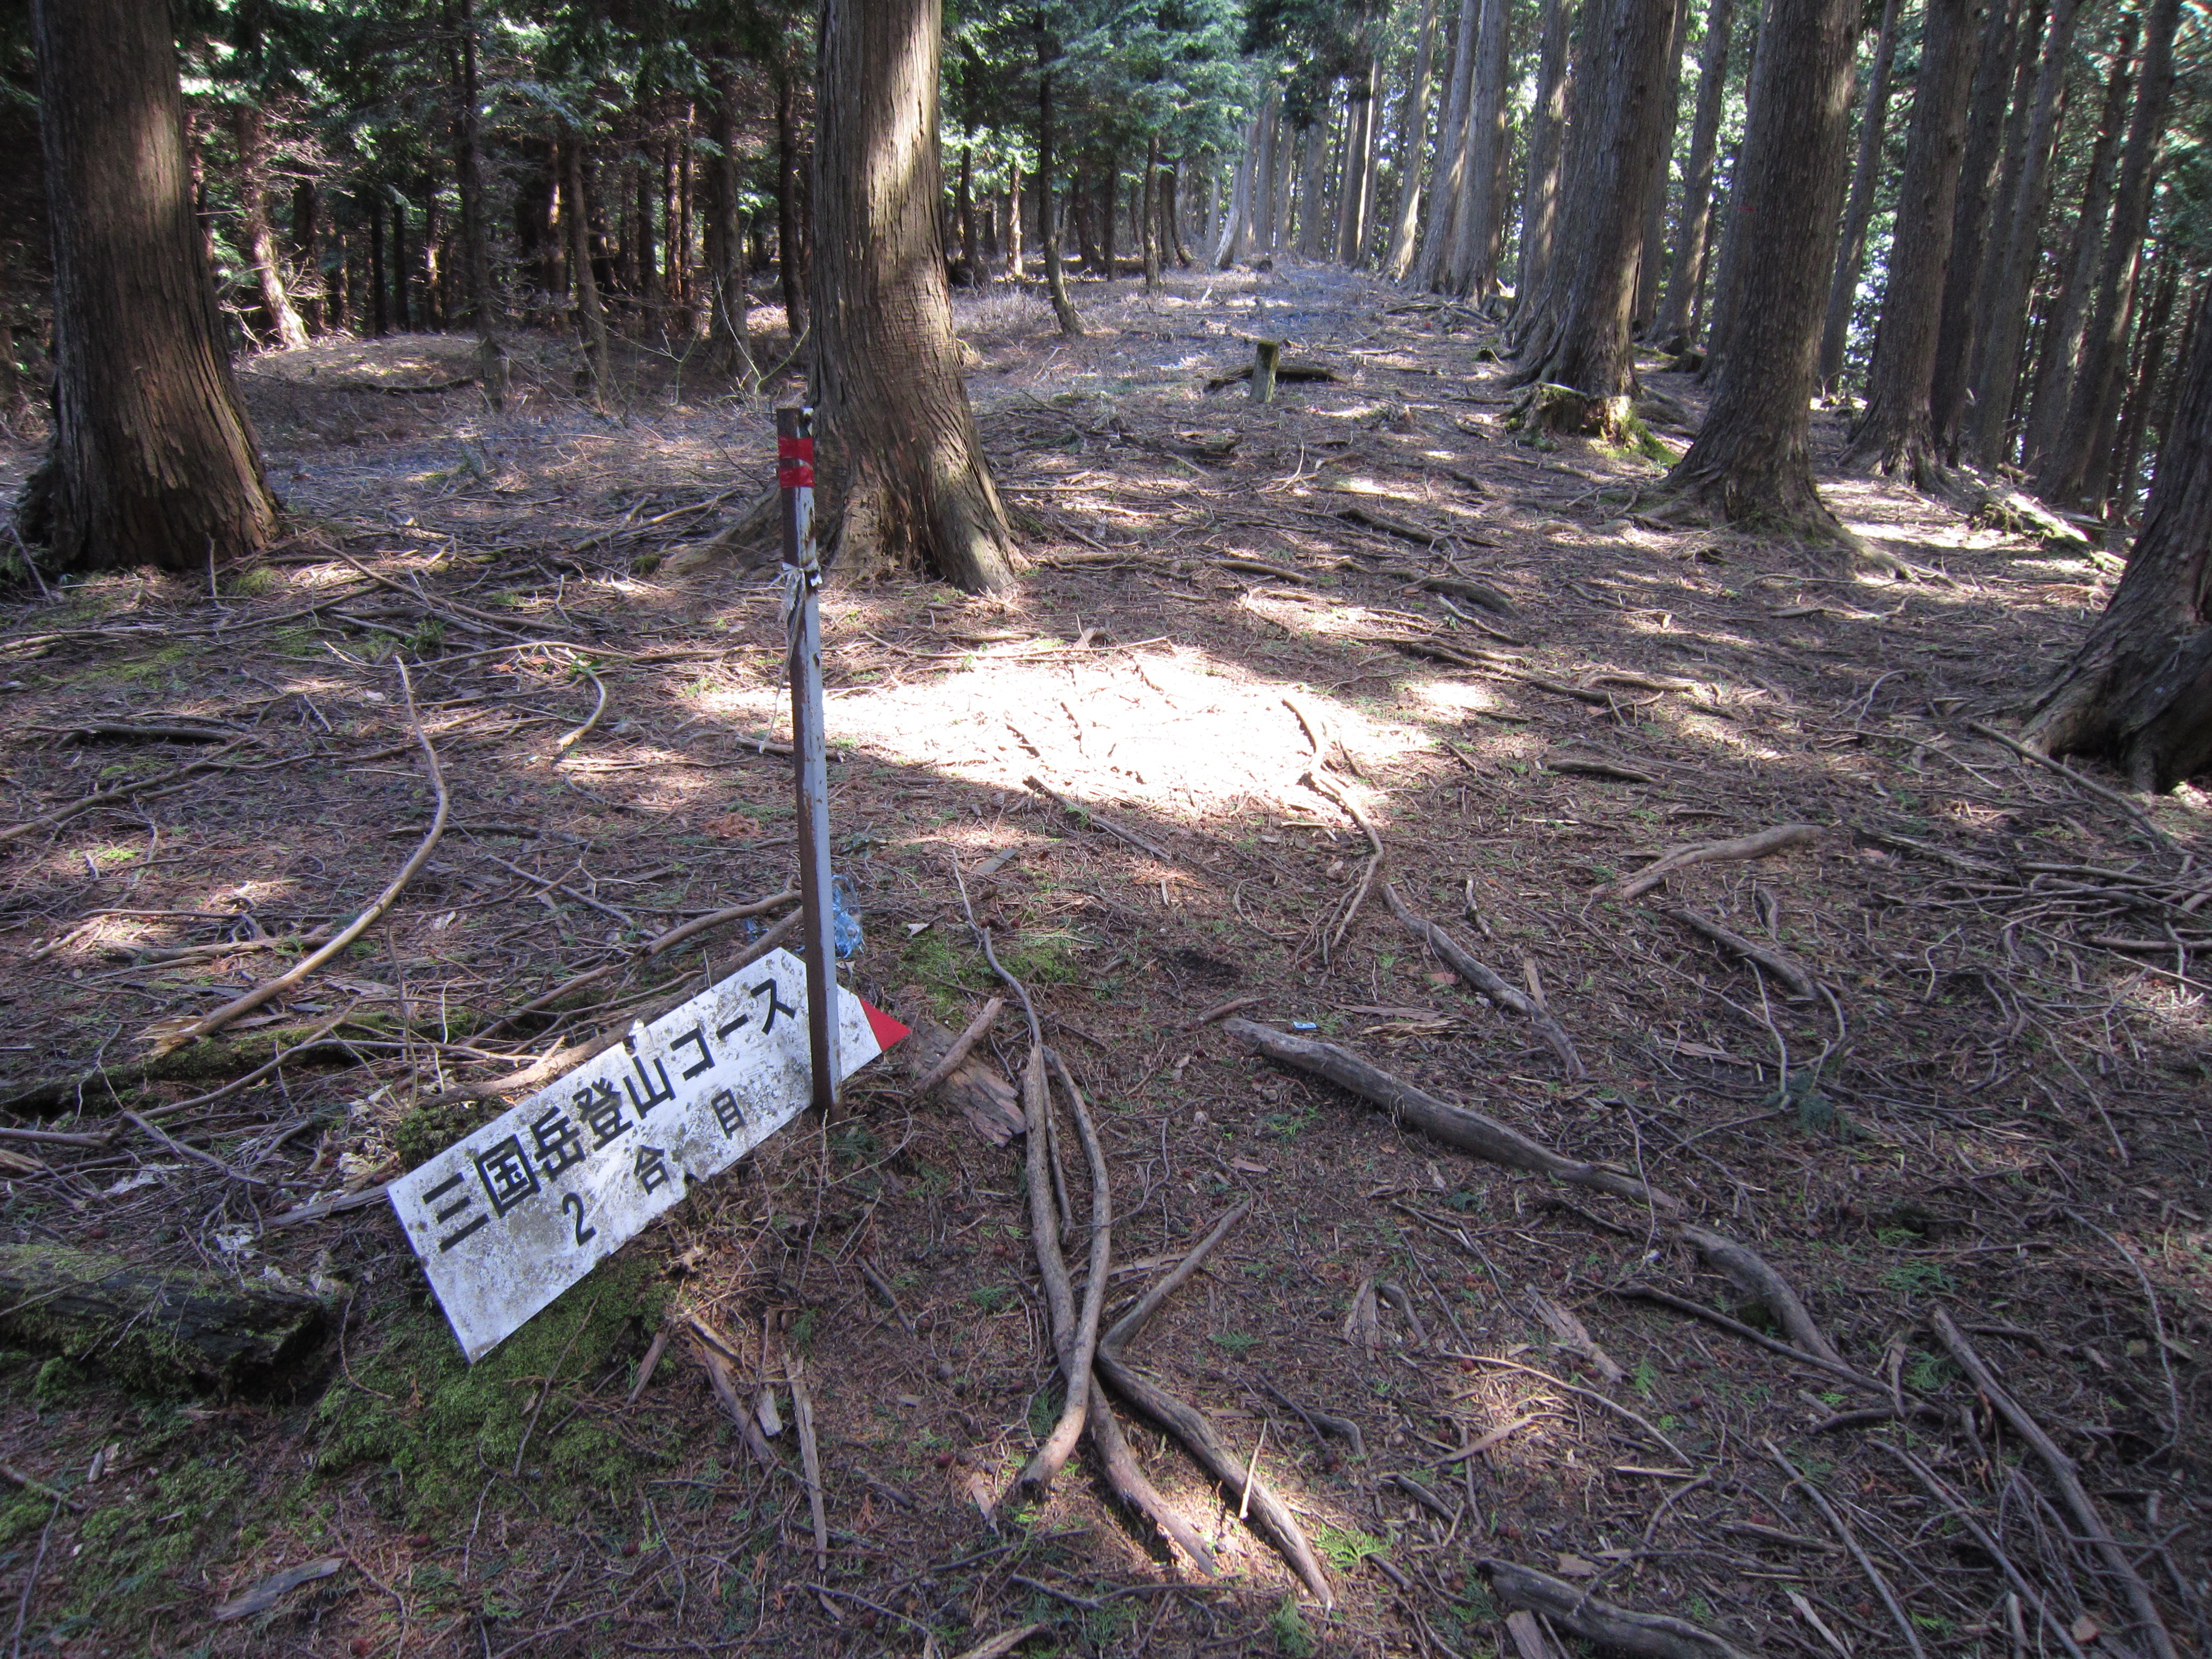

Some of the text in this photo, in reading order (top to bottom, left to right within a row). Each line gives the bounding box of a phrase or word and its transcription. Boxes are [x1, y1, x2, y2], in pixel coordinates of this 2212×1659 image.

[422, 977, 795, 1252] 三国岳登山コース
